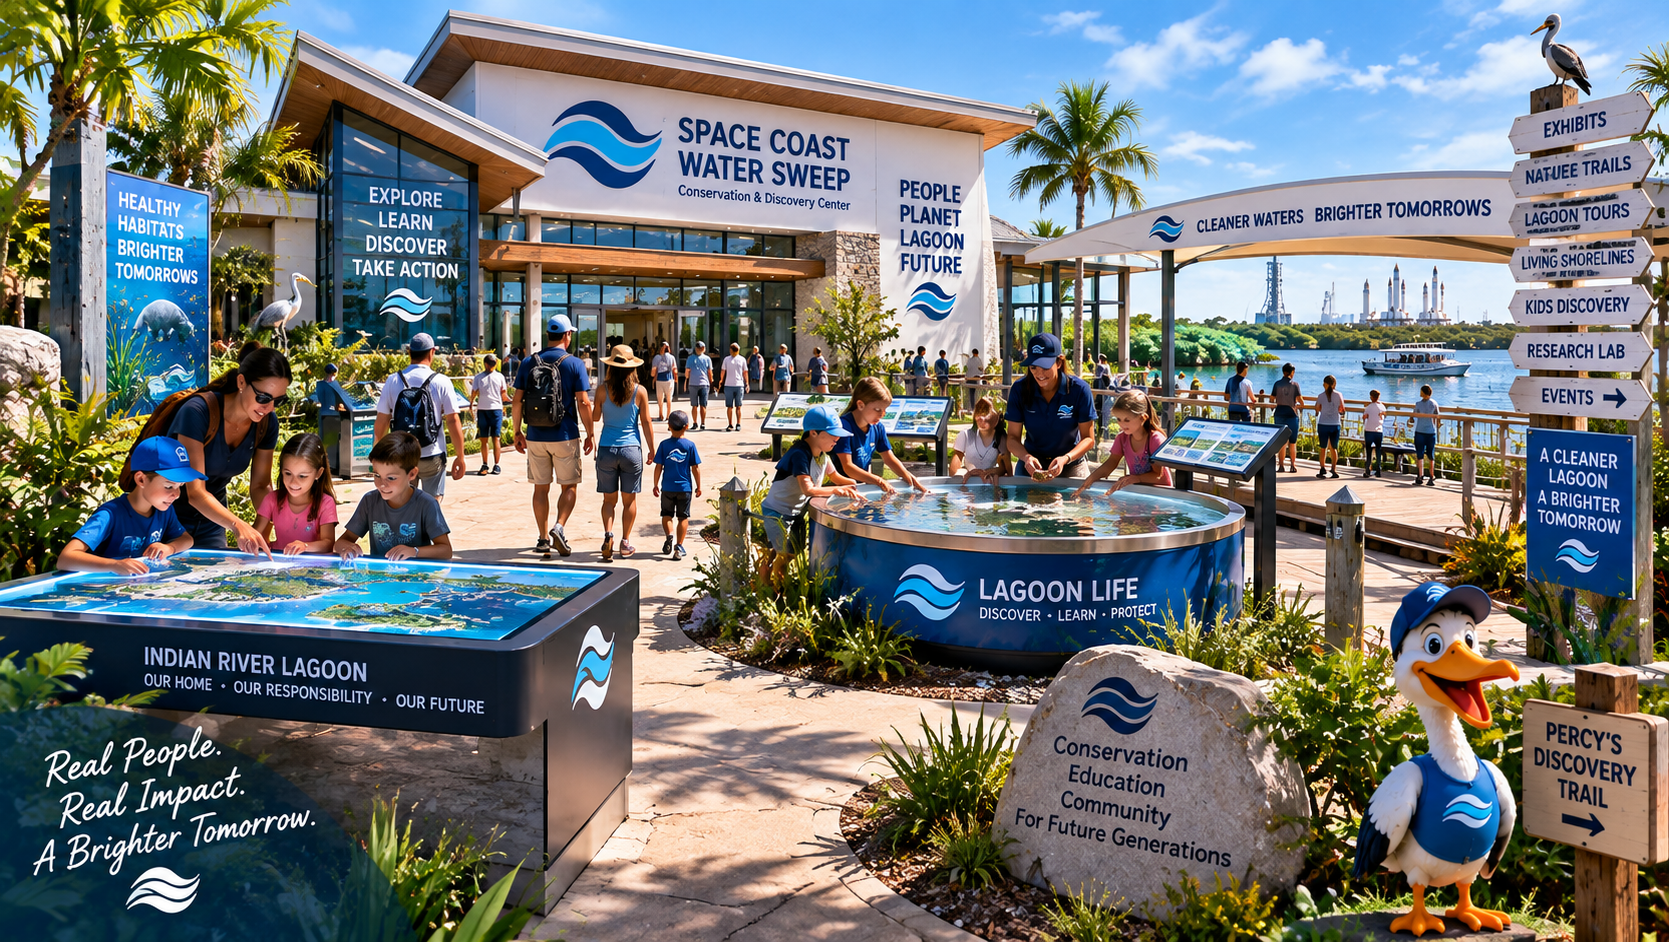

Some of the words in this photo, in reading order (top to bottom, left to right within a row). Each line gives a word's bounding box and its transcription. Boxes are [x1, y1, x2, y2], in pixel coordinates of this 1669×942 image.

[1543, 111, 1607, 138] EXHIBITS
[678, 117, 761, 151] SPACE
[769, 129, 850, 161] COAST
[677, 150, 764, 184] WATER
[771, 161, 851, 192] SWEEP
[1581, 155, 1632, 176] TRAILS
[118, 191, 181, 217] HEALTHY
[369, 186, 443, 208] EXPLORE
[678, 184, 751, 202] Conservation
[753, 191, 762, 203] &
[764, 192, 815, 210] Discovery
[817, 197, 851, 211] Center
[900, 179, 961, 204] PEOPLE
[118, 214, 184, 240] HABITATS
[378, 211, 433, 231] LEARN
[900, 204, 962, 227] PLANET
[1196, 209, 1250, 233] CLEANER
[1253, 208, 1304, 228] WATERS
[1315, 202, 1382, 222] BRIGHTER
[1386, 199, 1492, 218] TOMORROWS
[1525, 208, 1579, 227] LAGOON
[1582, 202, 1630, 221] TOURS
[117, 239, 184, 263] BRIGHTER
[365, 234, 447, 256] DISCOVER
[900, 229, 964, 250] LAGOON
[352, 258, 395, 277] TAKE
[399, 261, 459, 279] ACTION
[901, 253, 962, 274] FUTURE
[1521, 256, 1558, 270] LIVING
[1561, 249, 1635, 268] SHORELINES
[115, 262, 198, 284] TOMORROWS
[1525, 300, 1553, 315] KIDS
[1557, 297, 1630, 314] DISCOVERY
[1527, 344, 1594, 359] RESEARCH
[1598, 344, 1625, 359] LAB
[1542, 388, 1594, 405] EVENTS
[1540, 447, 1549, 463] A
[1553, 449, 1618, 470] CLEANER
[1549, 468, 1608, 490] LAGOON
[1537, 490, 1547, 505] A
[1551, 491, 1620, 514] BRIGHTER
[1537, 509, 1622, 535] TOMORROW
[979, 578, 1083, 603] LAGOON
[1092, 577, 1139, 602] LIFE
[979, 607, 1041, 622] DISCOVER
[1058, 609, 1097, 622] LEARN
[1111, 603, 1157, 619] PROTECT
[144, 646, 211, 670] INDIAN
[218, 651, 275, 675] RIVER
[282, 656, 368, 682] LAGOON
[144, 673, 171, 689] OUR
[175, 676, 212, 691] HOME
[233, 680, 262, 696] OUR
[266, 683, 373, 705] RESPONSIBILITY
[395, 693, 426, 710] OUR
[430, 697, 485, 715] FUTURE
[1546, 721, 1622, 755] PERCY'S
[1053, 735, 1189, 772] Conservation
[1534, 746, 1637, 787] DISCOVERY
[1068, 764, 1166, 798] Education
[1557, 778, 1609, 809] TRAIL
[1060, 790, 1172, 831] Community
[1015, 807, 1044, 829] For
[1048, 814, 1107, 842] Future
[1111, 827, 1232, 868] Generations
